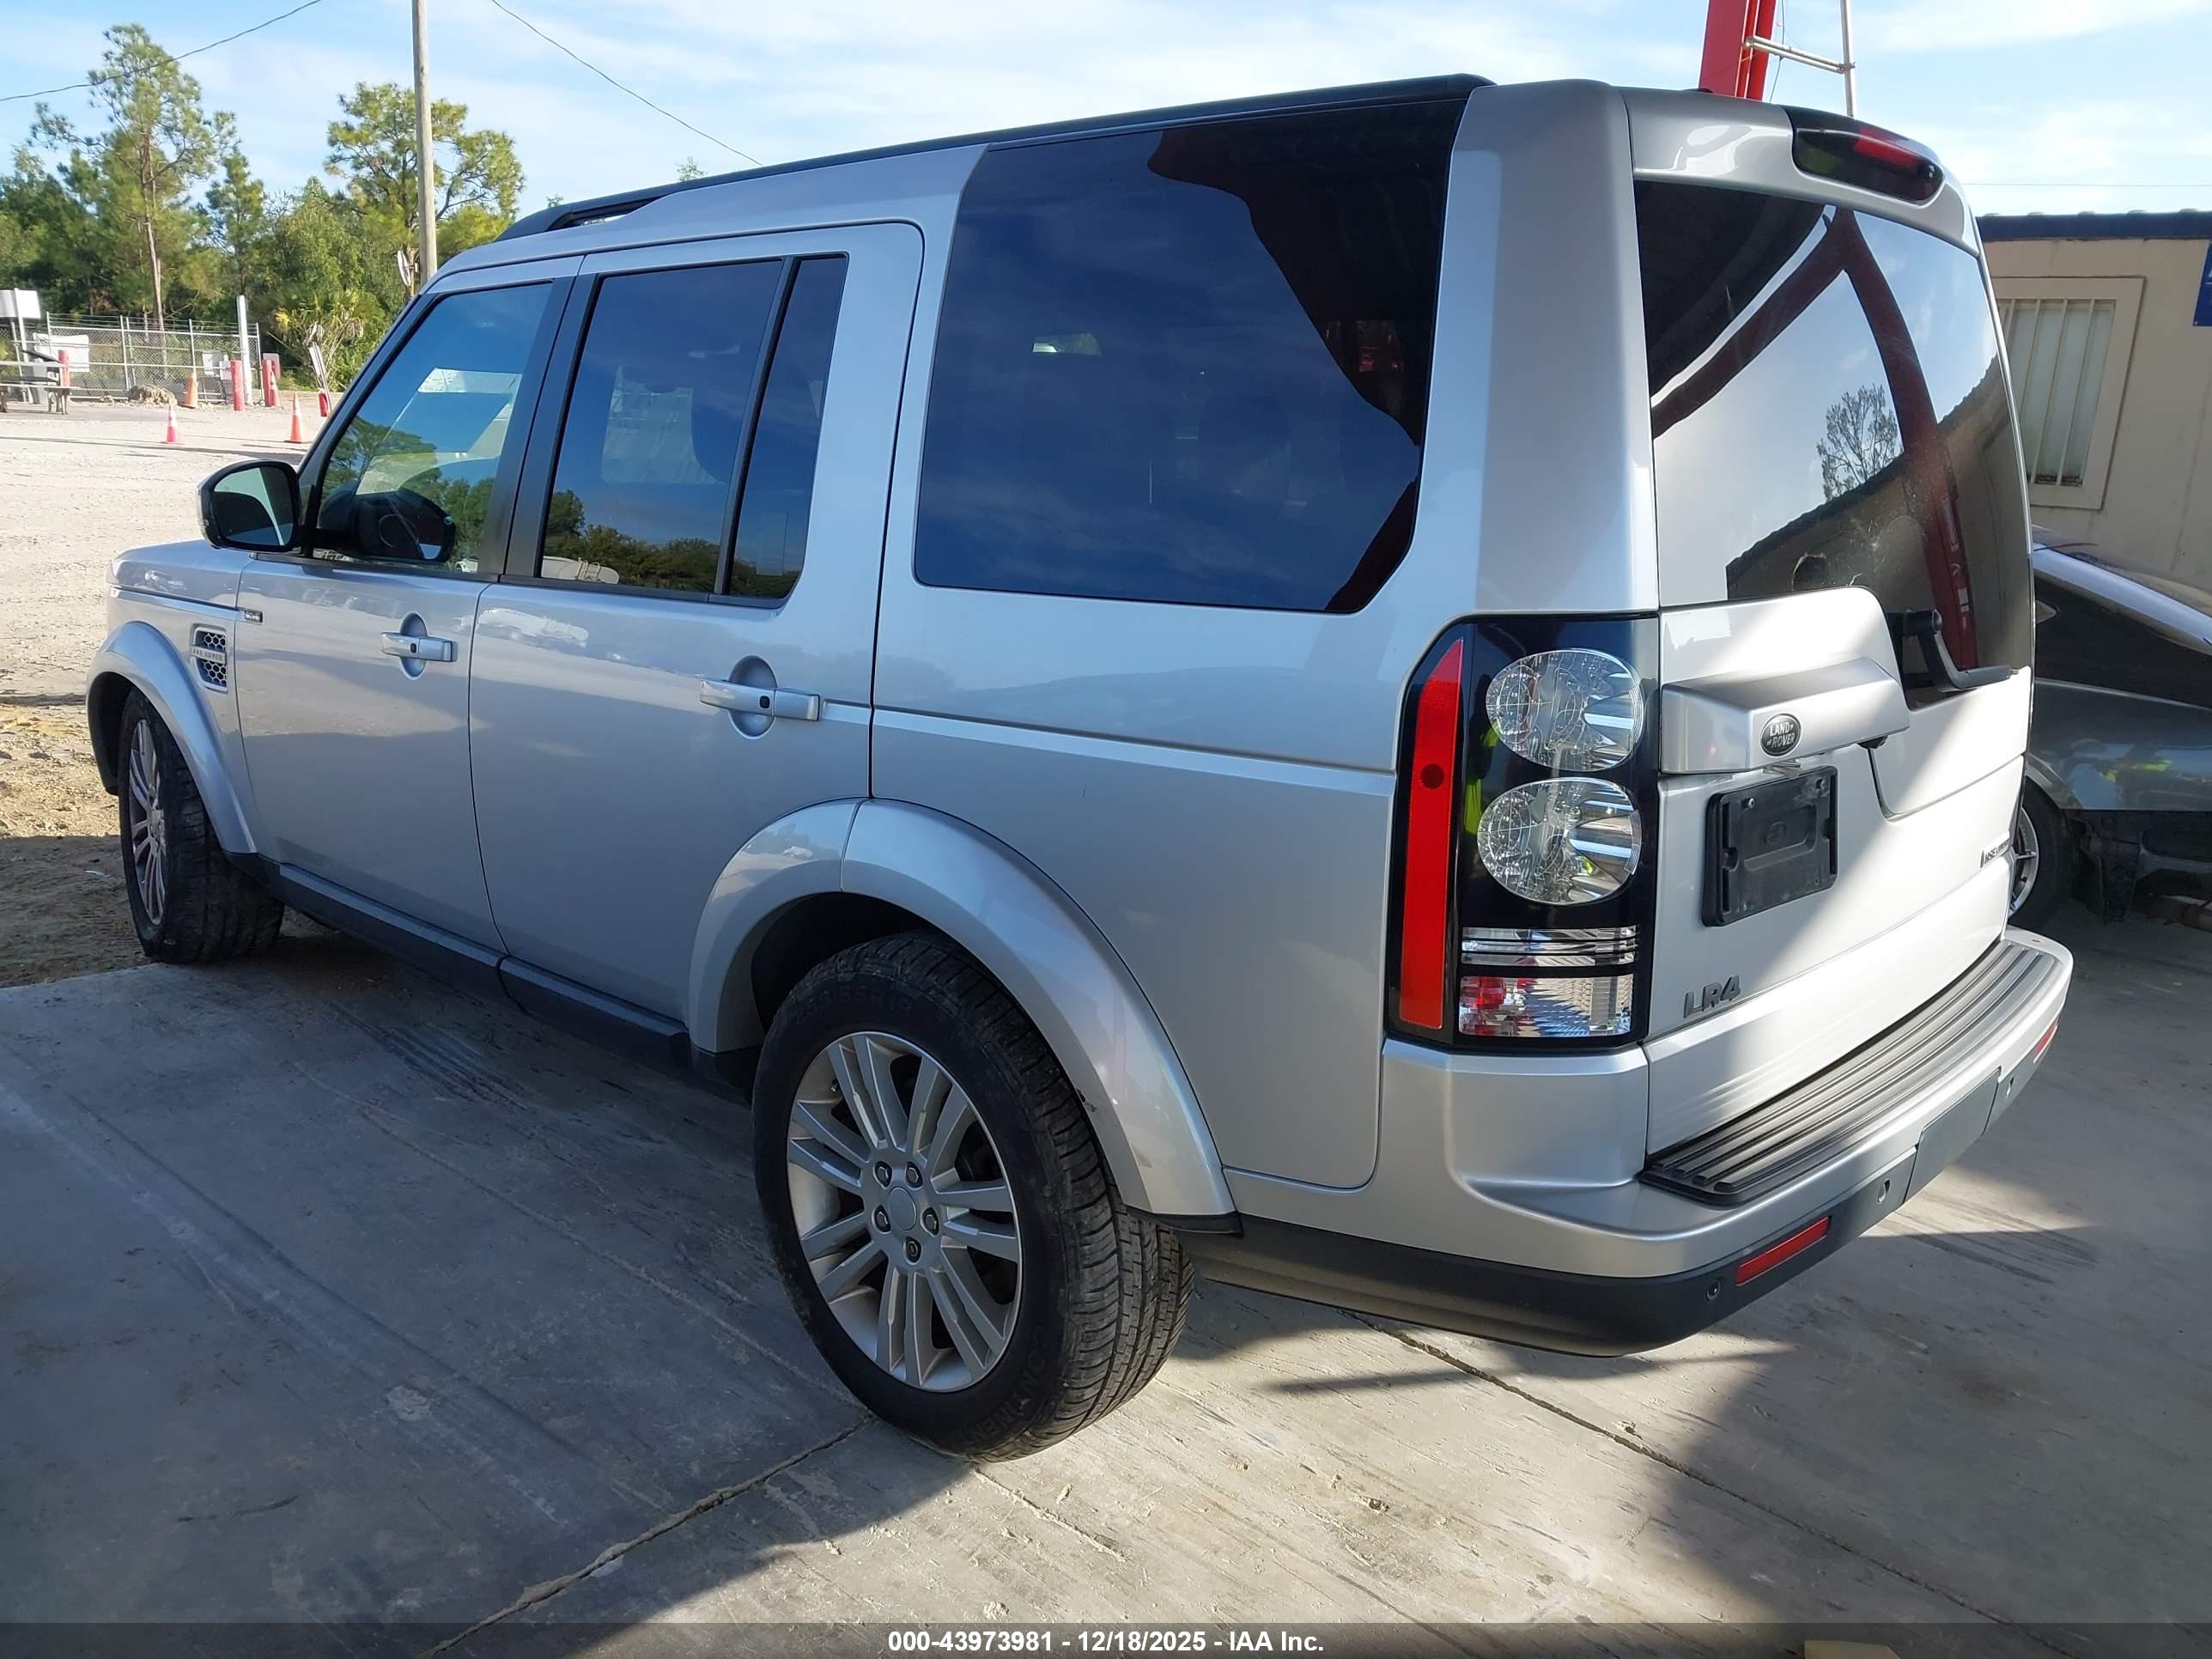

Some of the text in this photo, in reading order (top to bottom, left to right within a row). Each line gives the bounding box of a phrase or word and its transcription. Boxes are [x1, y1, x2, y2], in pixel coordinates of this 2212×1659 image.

[1770, 721, 1790, 737] LAND
[1771, 732, 1796, 749] ROVER
[1683, 974, 1741, 1018] LR4
